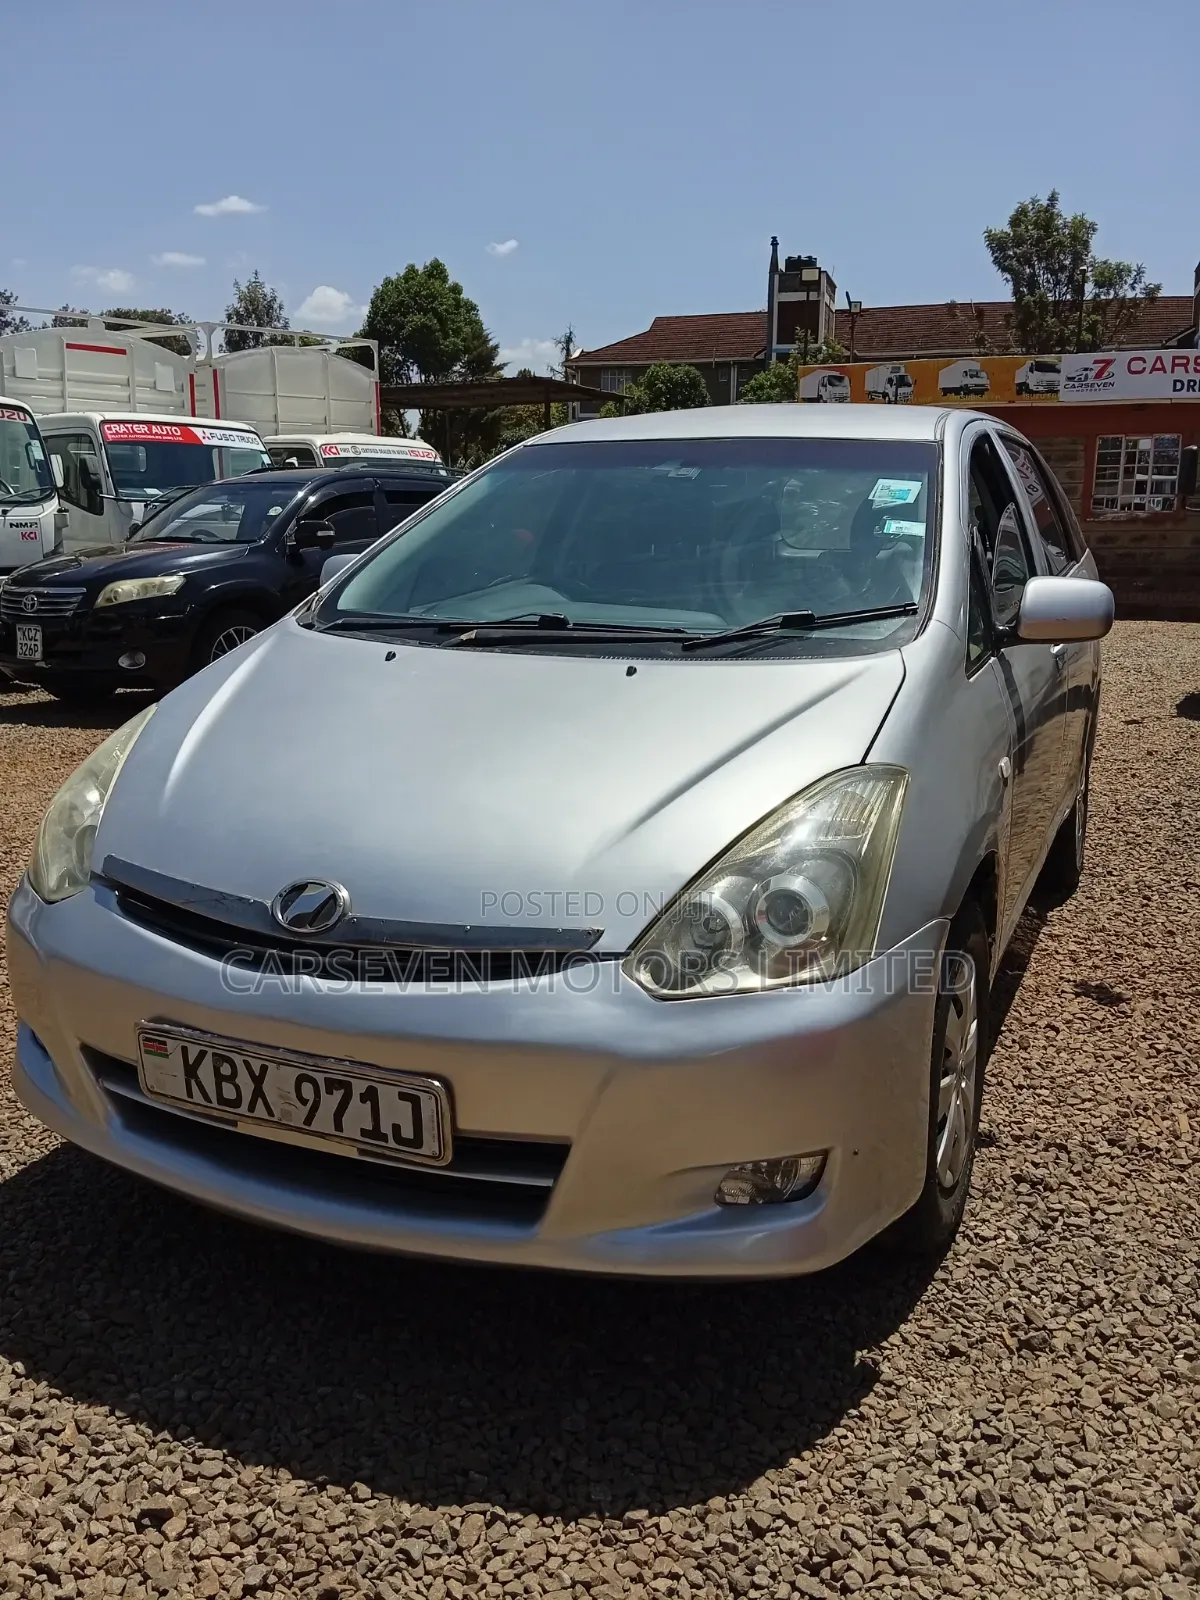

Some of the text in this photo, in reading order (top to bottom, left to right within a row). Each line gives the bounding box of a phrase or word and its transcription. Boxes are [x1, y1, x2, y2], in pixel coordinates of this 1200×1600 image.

[1063, 381, 1116, 390] CARSEVEN
[104, 423, 181, 436] CRATER AUTO
[210, 432, 260, 446] FUSO TRUCKS
[321, 445, 340, 456] KCI
[407, 449, 438, 459] ISUZU
[20, 531, 38, 540] KCI
[22, 627, 39, 641] KCZ
[18, 642, 39, 657] 326P
[181, 1045, 275, 1118] KBX
[294, 1073, 424, 1150] 971J
